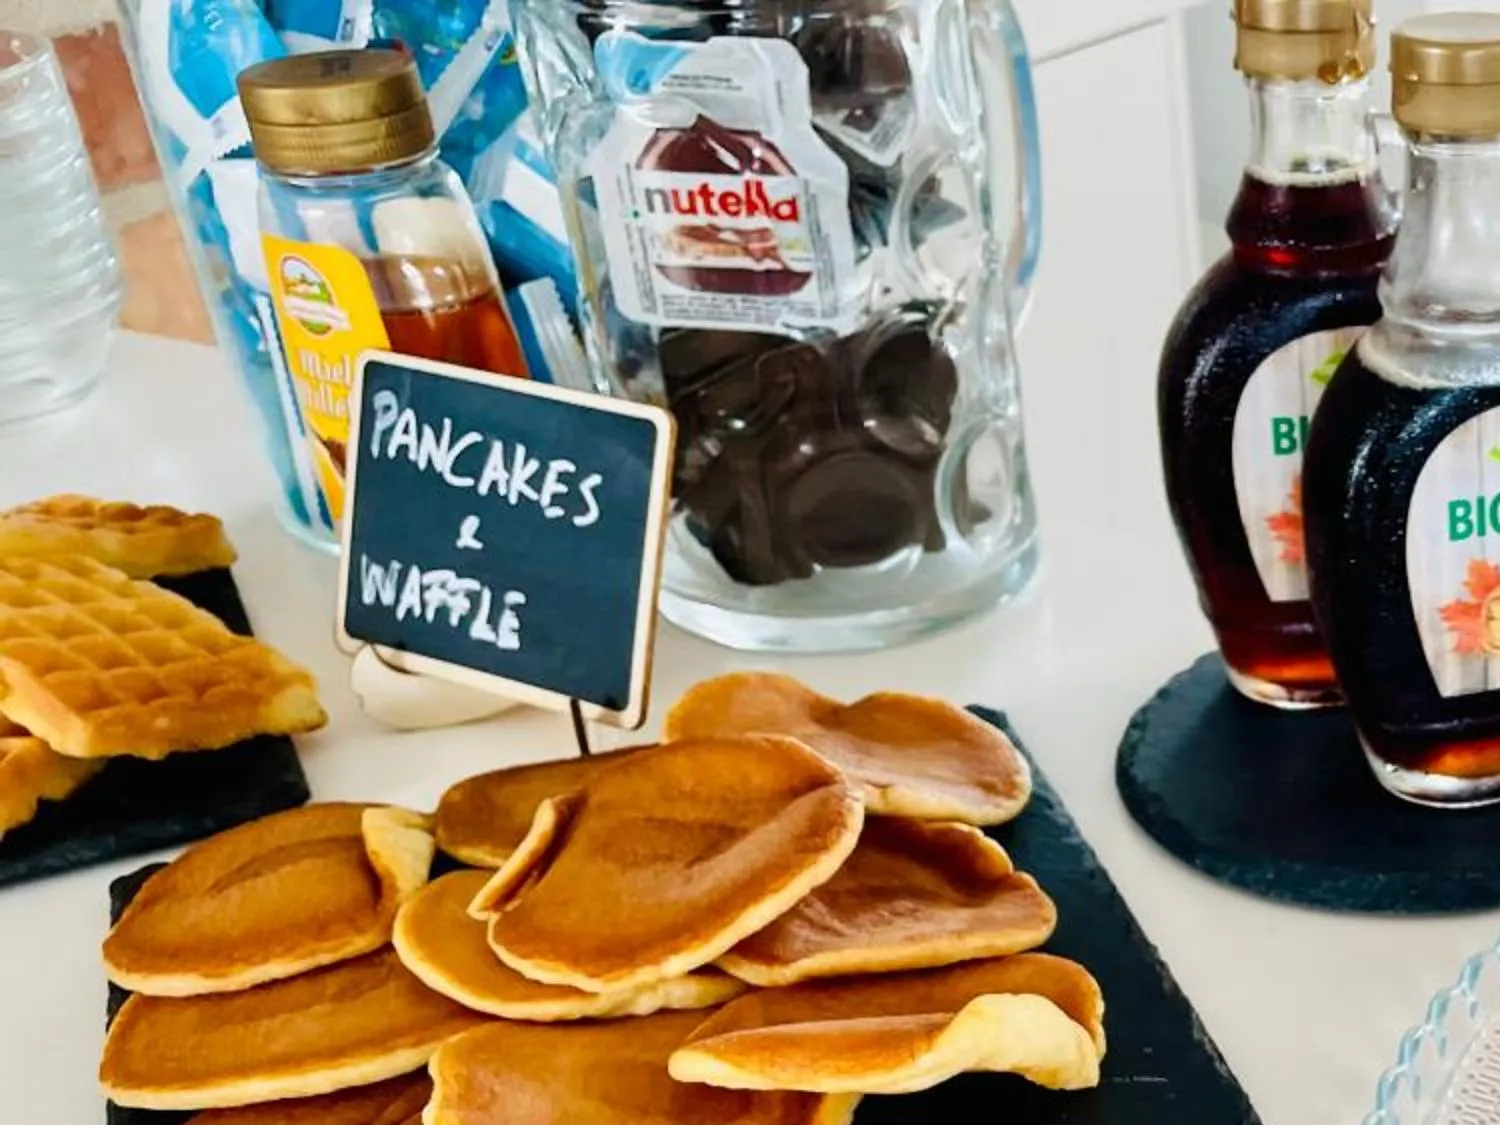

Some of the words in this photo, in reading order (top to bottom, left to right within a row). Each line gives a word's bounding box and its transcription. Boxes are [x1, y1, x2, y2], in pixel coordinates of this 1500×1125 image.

[644, 179, 800, 223] nutella
[369, 389, 603, 528] PANCAKES
[1272, 415, 1309, 456] BI
[359, 554, 528, 650] WAFFLE
